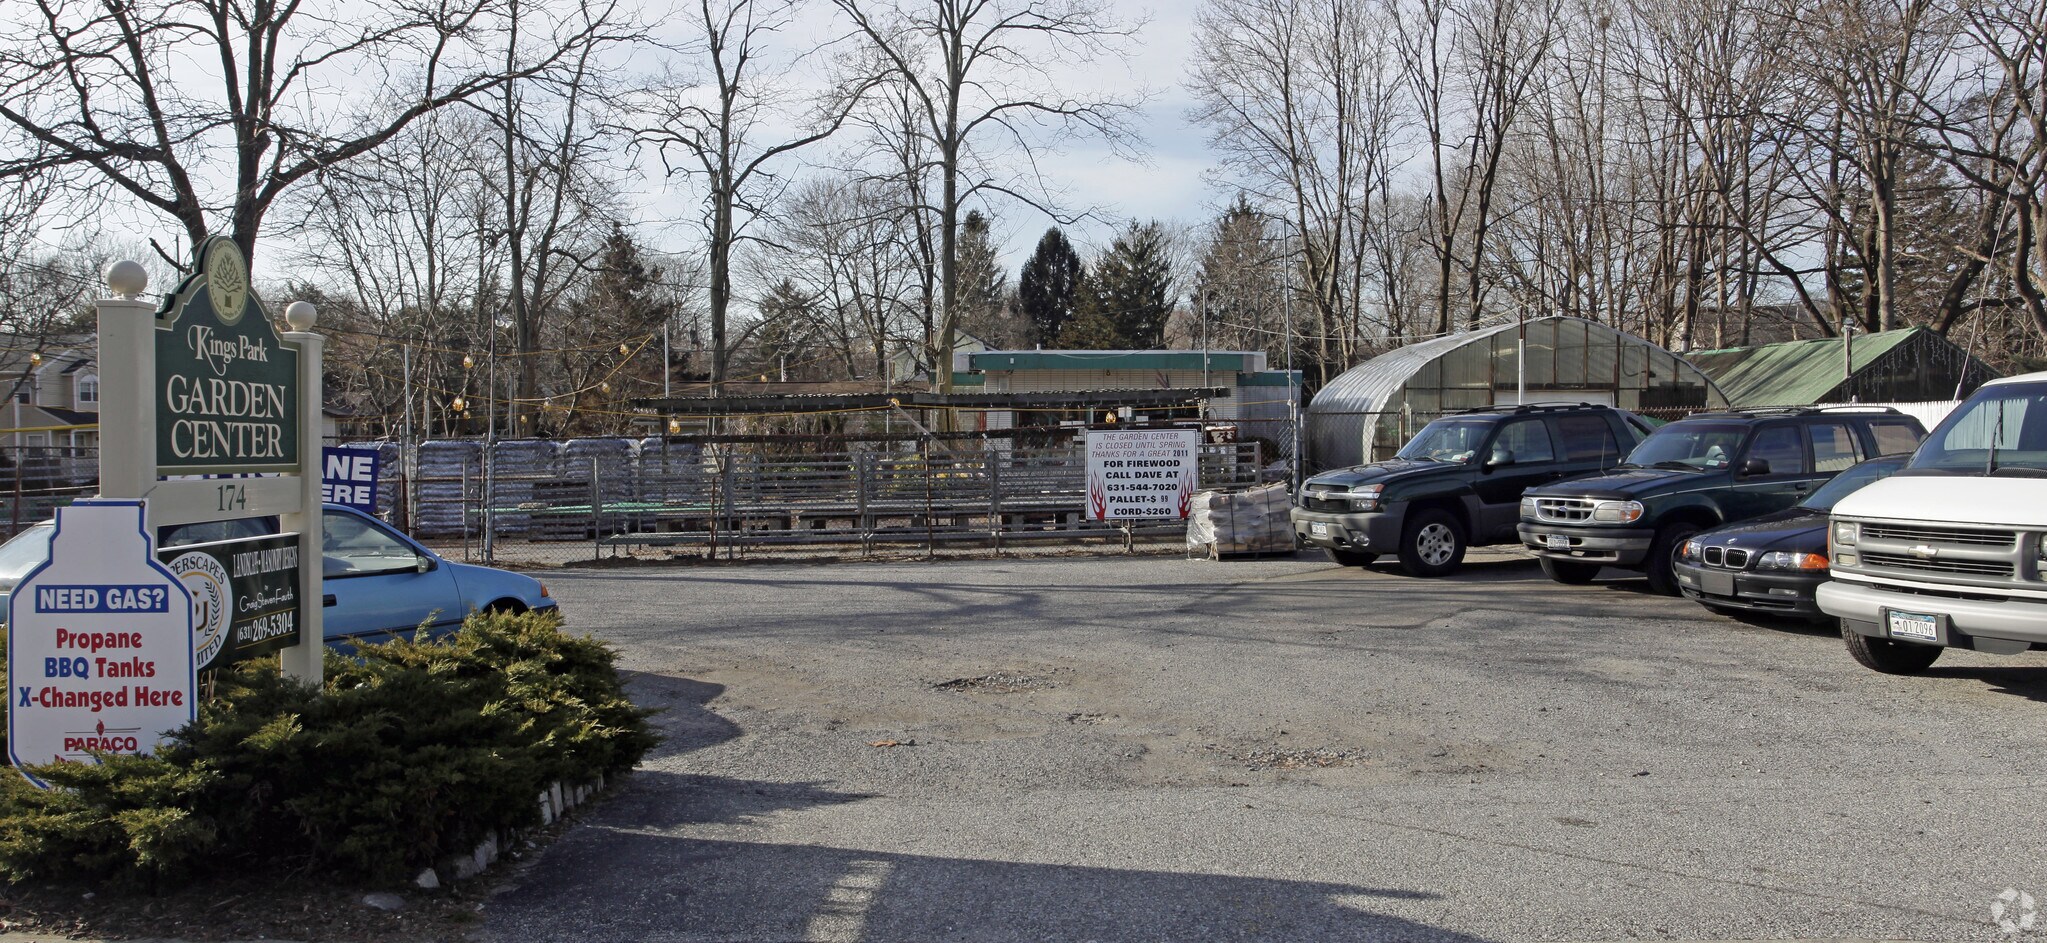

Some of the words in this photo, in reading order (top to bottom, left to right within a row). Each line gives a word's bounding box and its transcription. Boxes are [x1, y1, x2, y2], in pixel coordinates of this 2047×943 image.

[187, 324, 237, 377] Kings
[238, 335, 268, 362] Park
[166, 374, 286, 419] GARDEN
[171, 419, 284, 459] CENTER
[1135, 441, 1156, 449] UNTIL
[1103, 460, 1124, 468] FOR
[1127, 459, 1180, 468] FIREWOOD
[1105, 471, 1131, 479] CALL
[1135, 471, 1162, 479] DAVE
[1165, 471, 1179, 479] AT
[217, 484, 247, 511] 174
[1114, 508, 1171, 516] CORD-$260
[40, 588, 99, 610] NEED
[106, 588, 165, 610] GAS?
[56, 628, 143, 653] Propane
[45, 657, 89, 680] BBQ
[95, 656, 155, 678] Tanks
[19, 686, 128, 712] X-Changed
[135, 686, 183, 707] Here
[64, 737, 138, 752] PARACO
